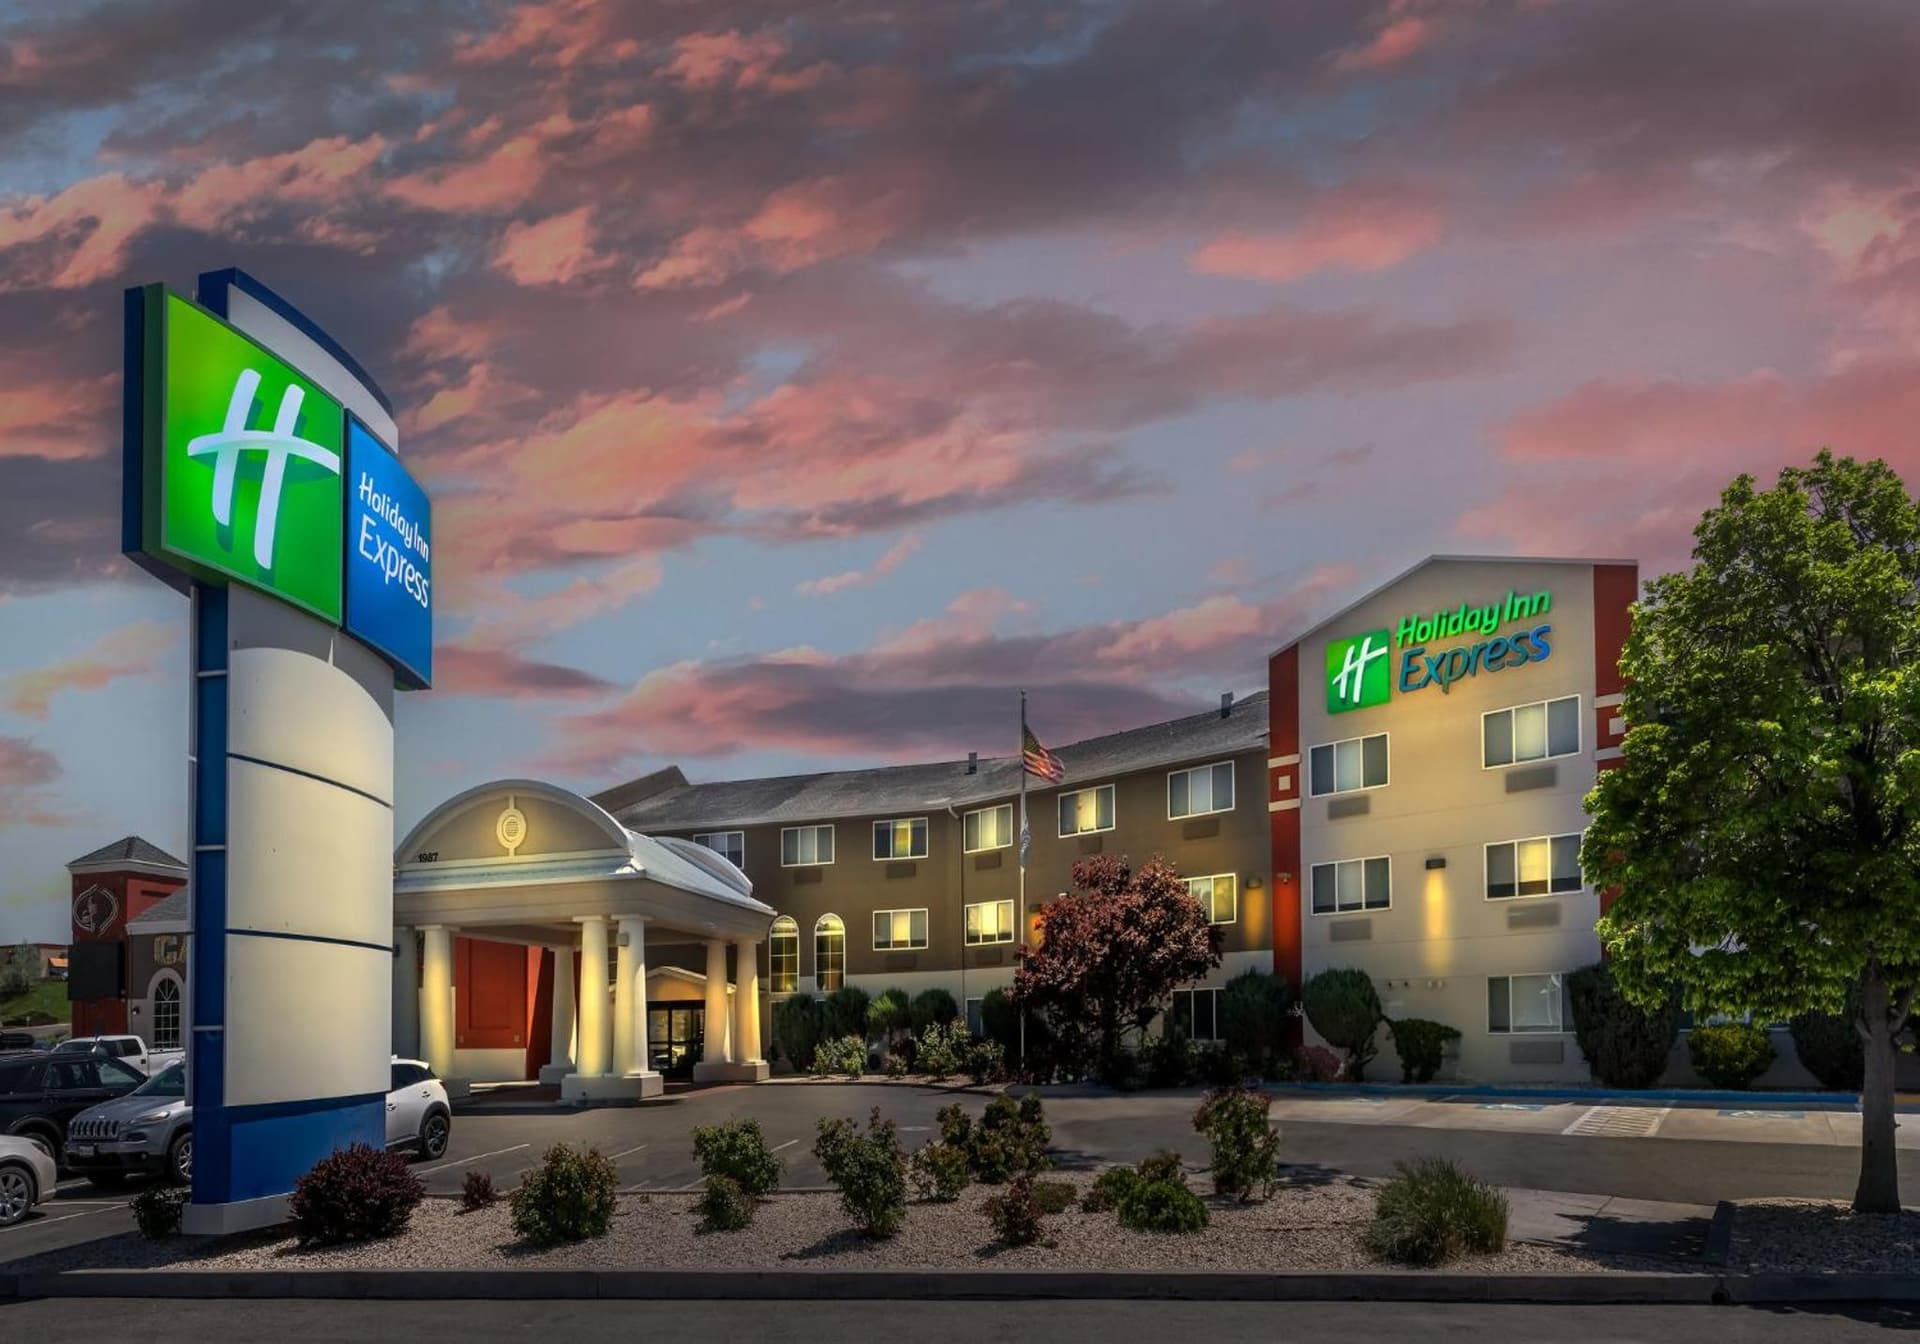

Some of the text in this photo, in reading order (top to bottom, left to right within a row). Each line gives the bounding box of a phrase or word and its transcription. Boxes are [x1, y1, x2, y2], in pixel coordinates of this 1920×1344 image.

[359, 472, 429, 563] Holiday Inn
[360, 514, 429, 608] Express
[1396, 590, 1551, 648] Holiday Inn
[1398, 624, 1553, 694] Express
